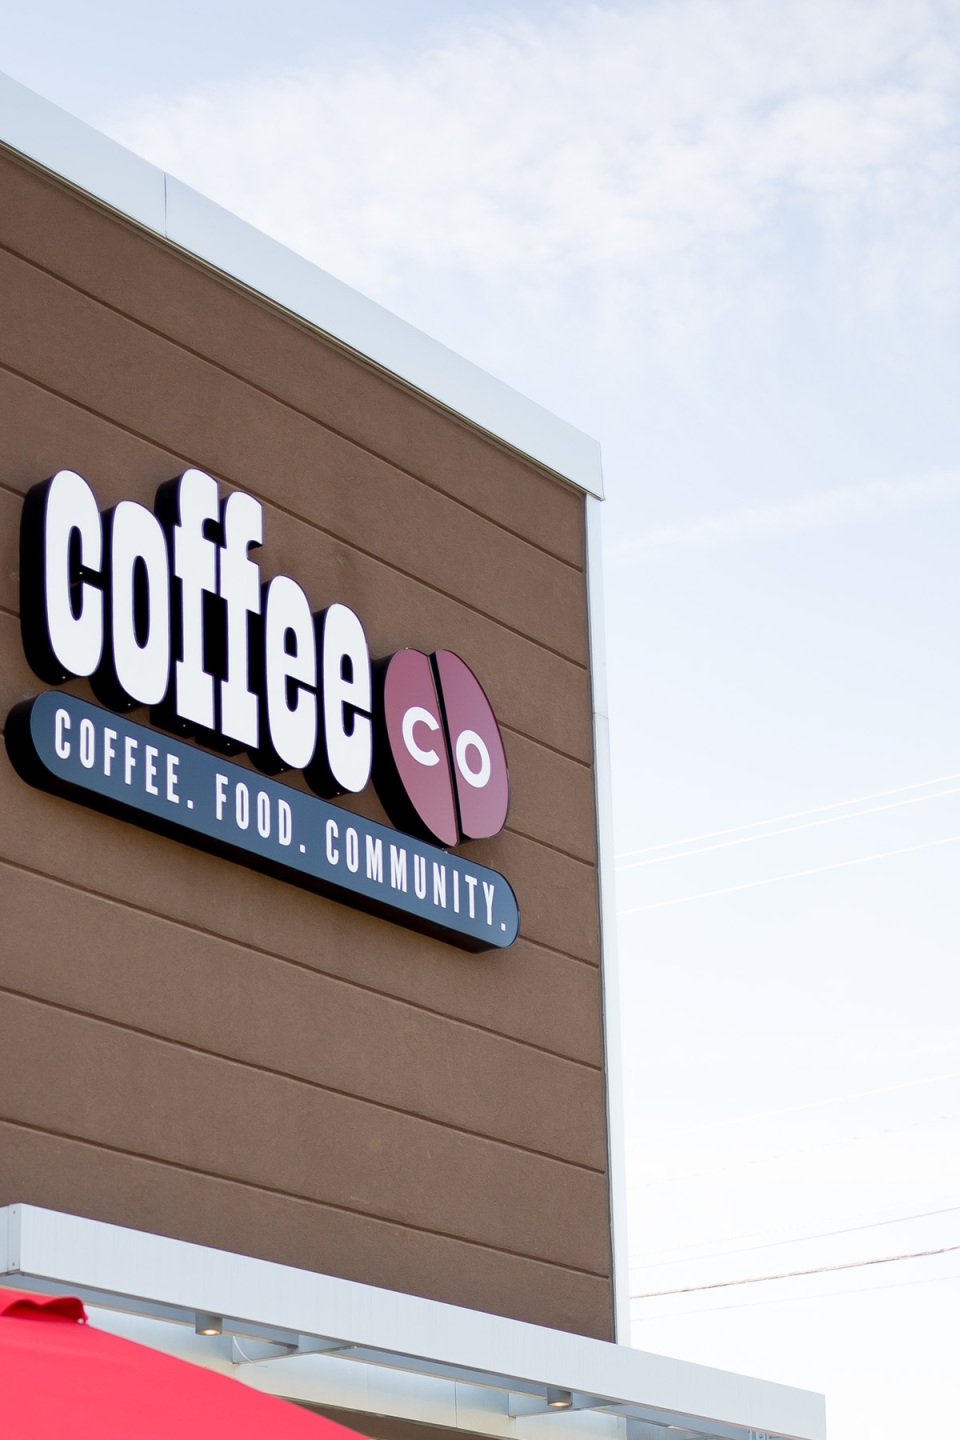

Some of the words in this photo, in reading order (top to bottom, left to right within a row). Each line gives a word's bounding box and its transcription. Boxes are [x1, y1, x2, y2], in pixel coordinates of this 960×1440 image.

[44, 467, 373, 794] coffee
[53, 707, 195, 810] COFFEE.
[214, 772, 307, 854] FOOD.
[324, 818, 507, 933] COMMUNITY.
